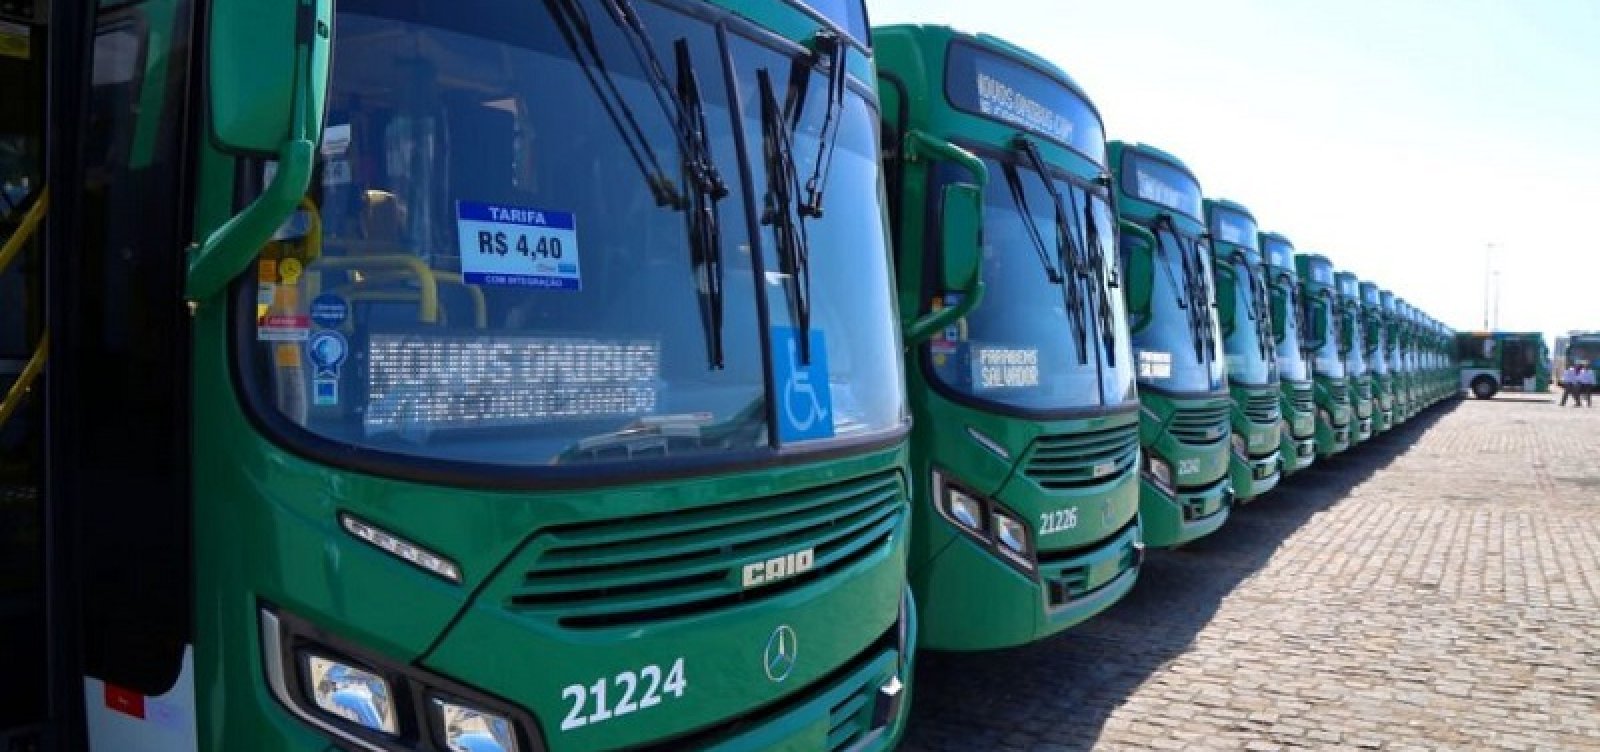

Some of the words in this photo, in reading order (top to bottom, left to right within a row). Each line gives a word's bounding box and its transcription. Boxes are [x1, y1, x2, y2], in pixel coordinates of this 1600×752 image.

[488, 206, 547, 225] TARIFA
[478, 230, 509, 257] R$
[516, 233, 563, 262] 4,40
[369, 341, 513, 386] NOVOS
[981, 365, 1039, 388] SALVADOR
[1039, 505, 1079, 536] 21226
[742, 547, 815, 588] CAIO
[560, 656, 688, 732] 21224
